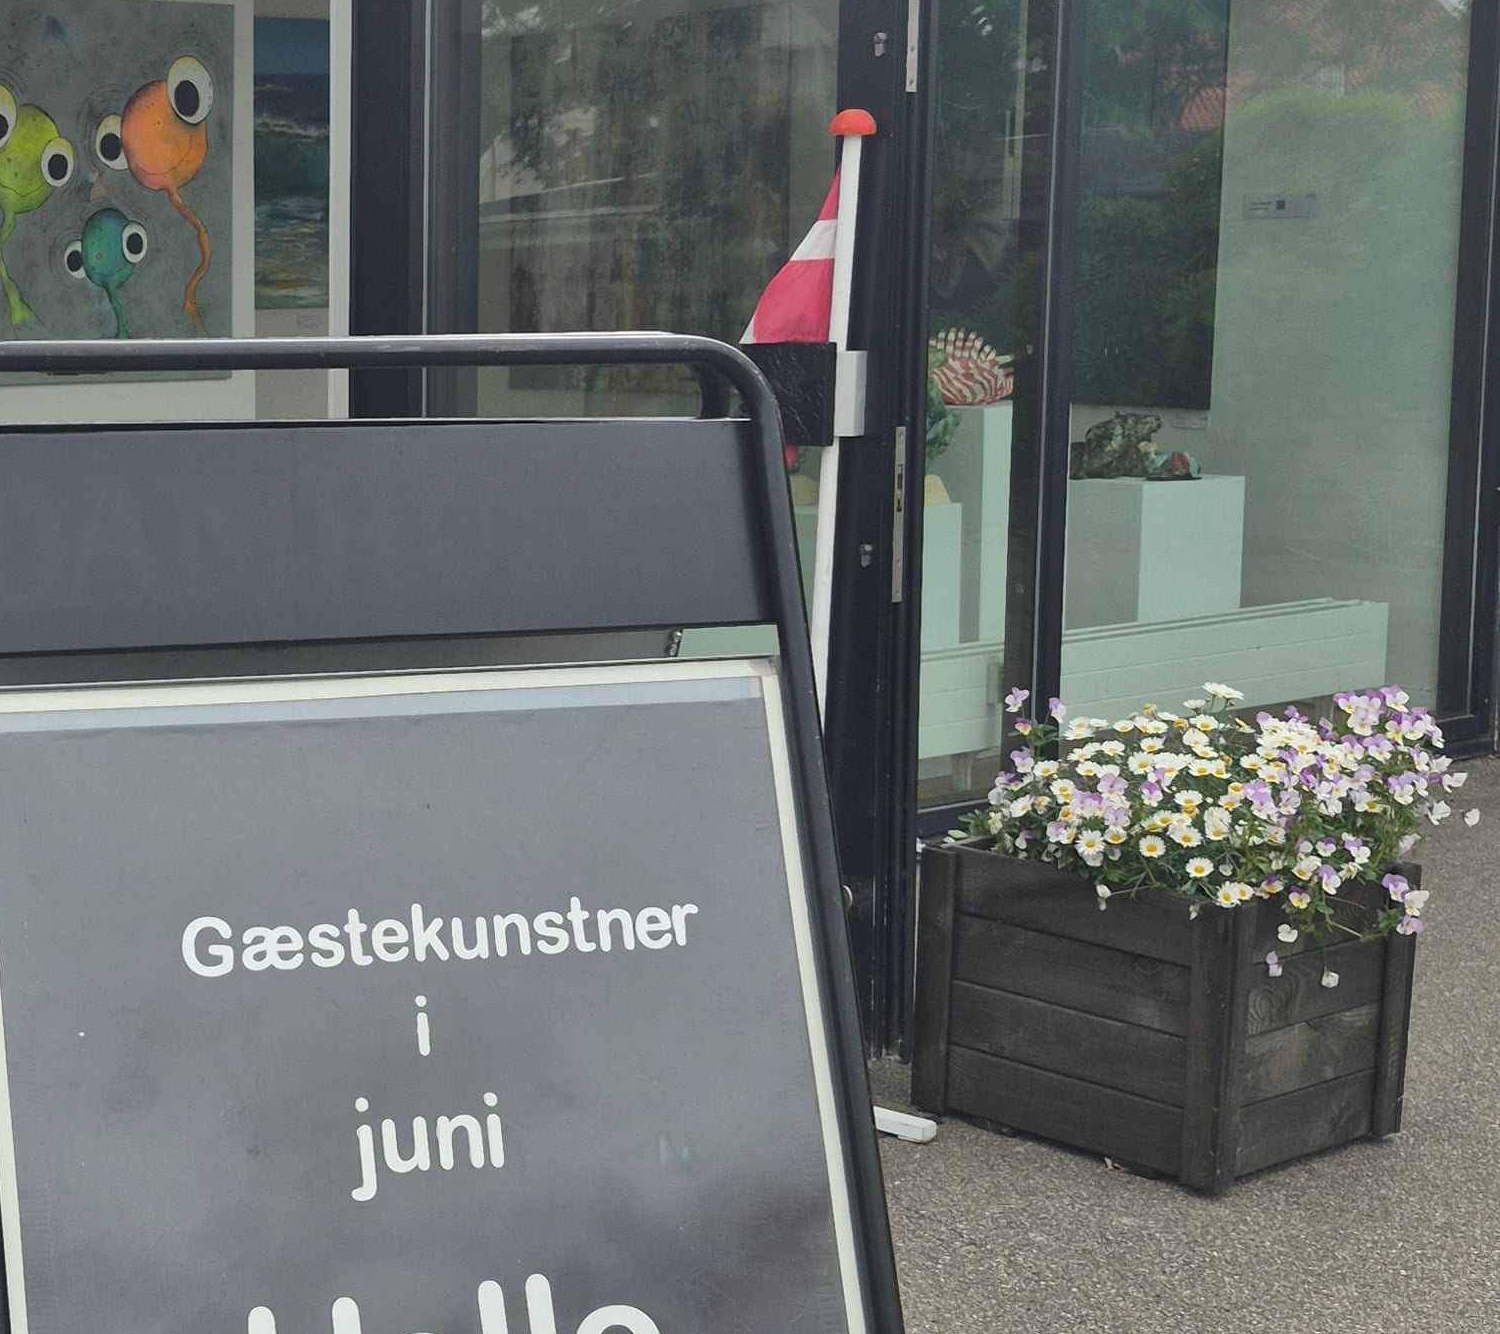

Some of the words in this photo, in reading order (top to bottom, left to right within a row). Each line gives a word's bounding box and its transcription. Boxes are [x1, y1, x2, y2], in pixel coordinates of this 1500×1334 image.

[181, 896, 699, 978] Gæstekunstner
[414, 995, 431, 1057] i
[351, 1092, 505, 1202] juni
